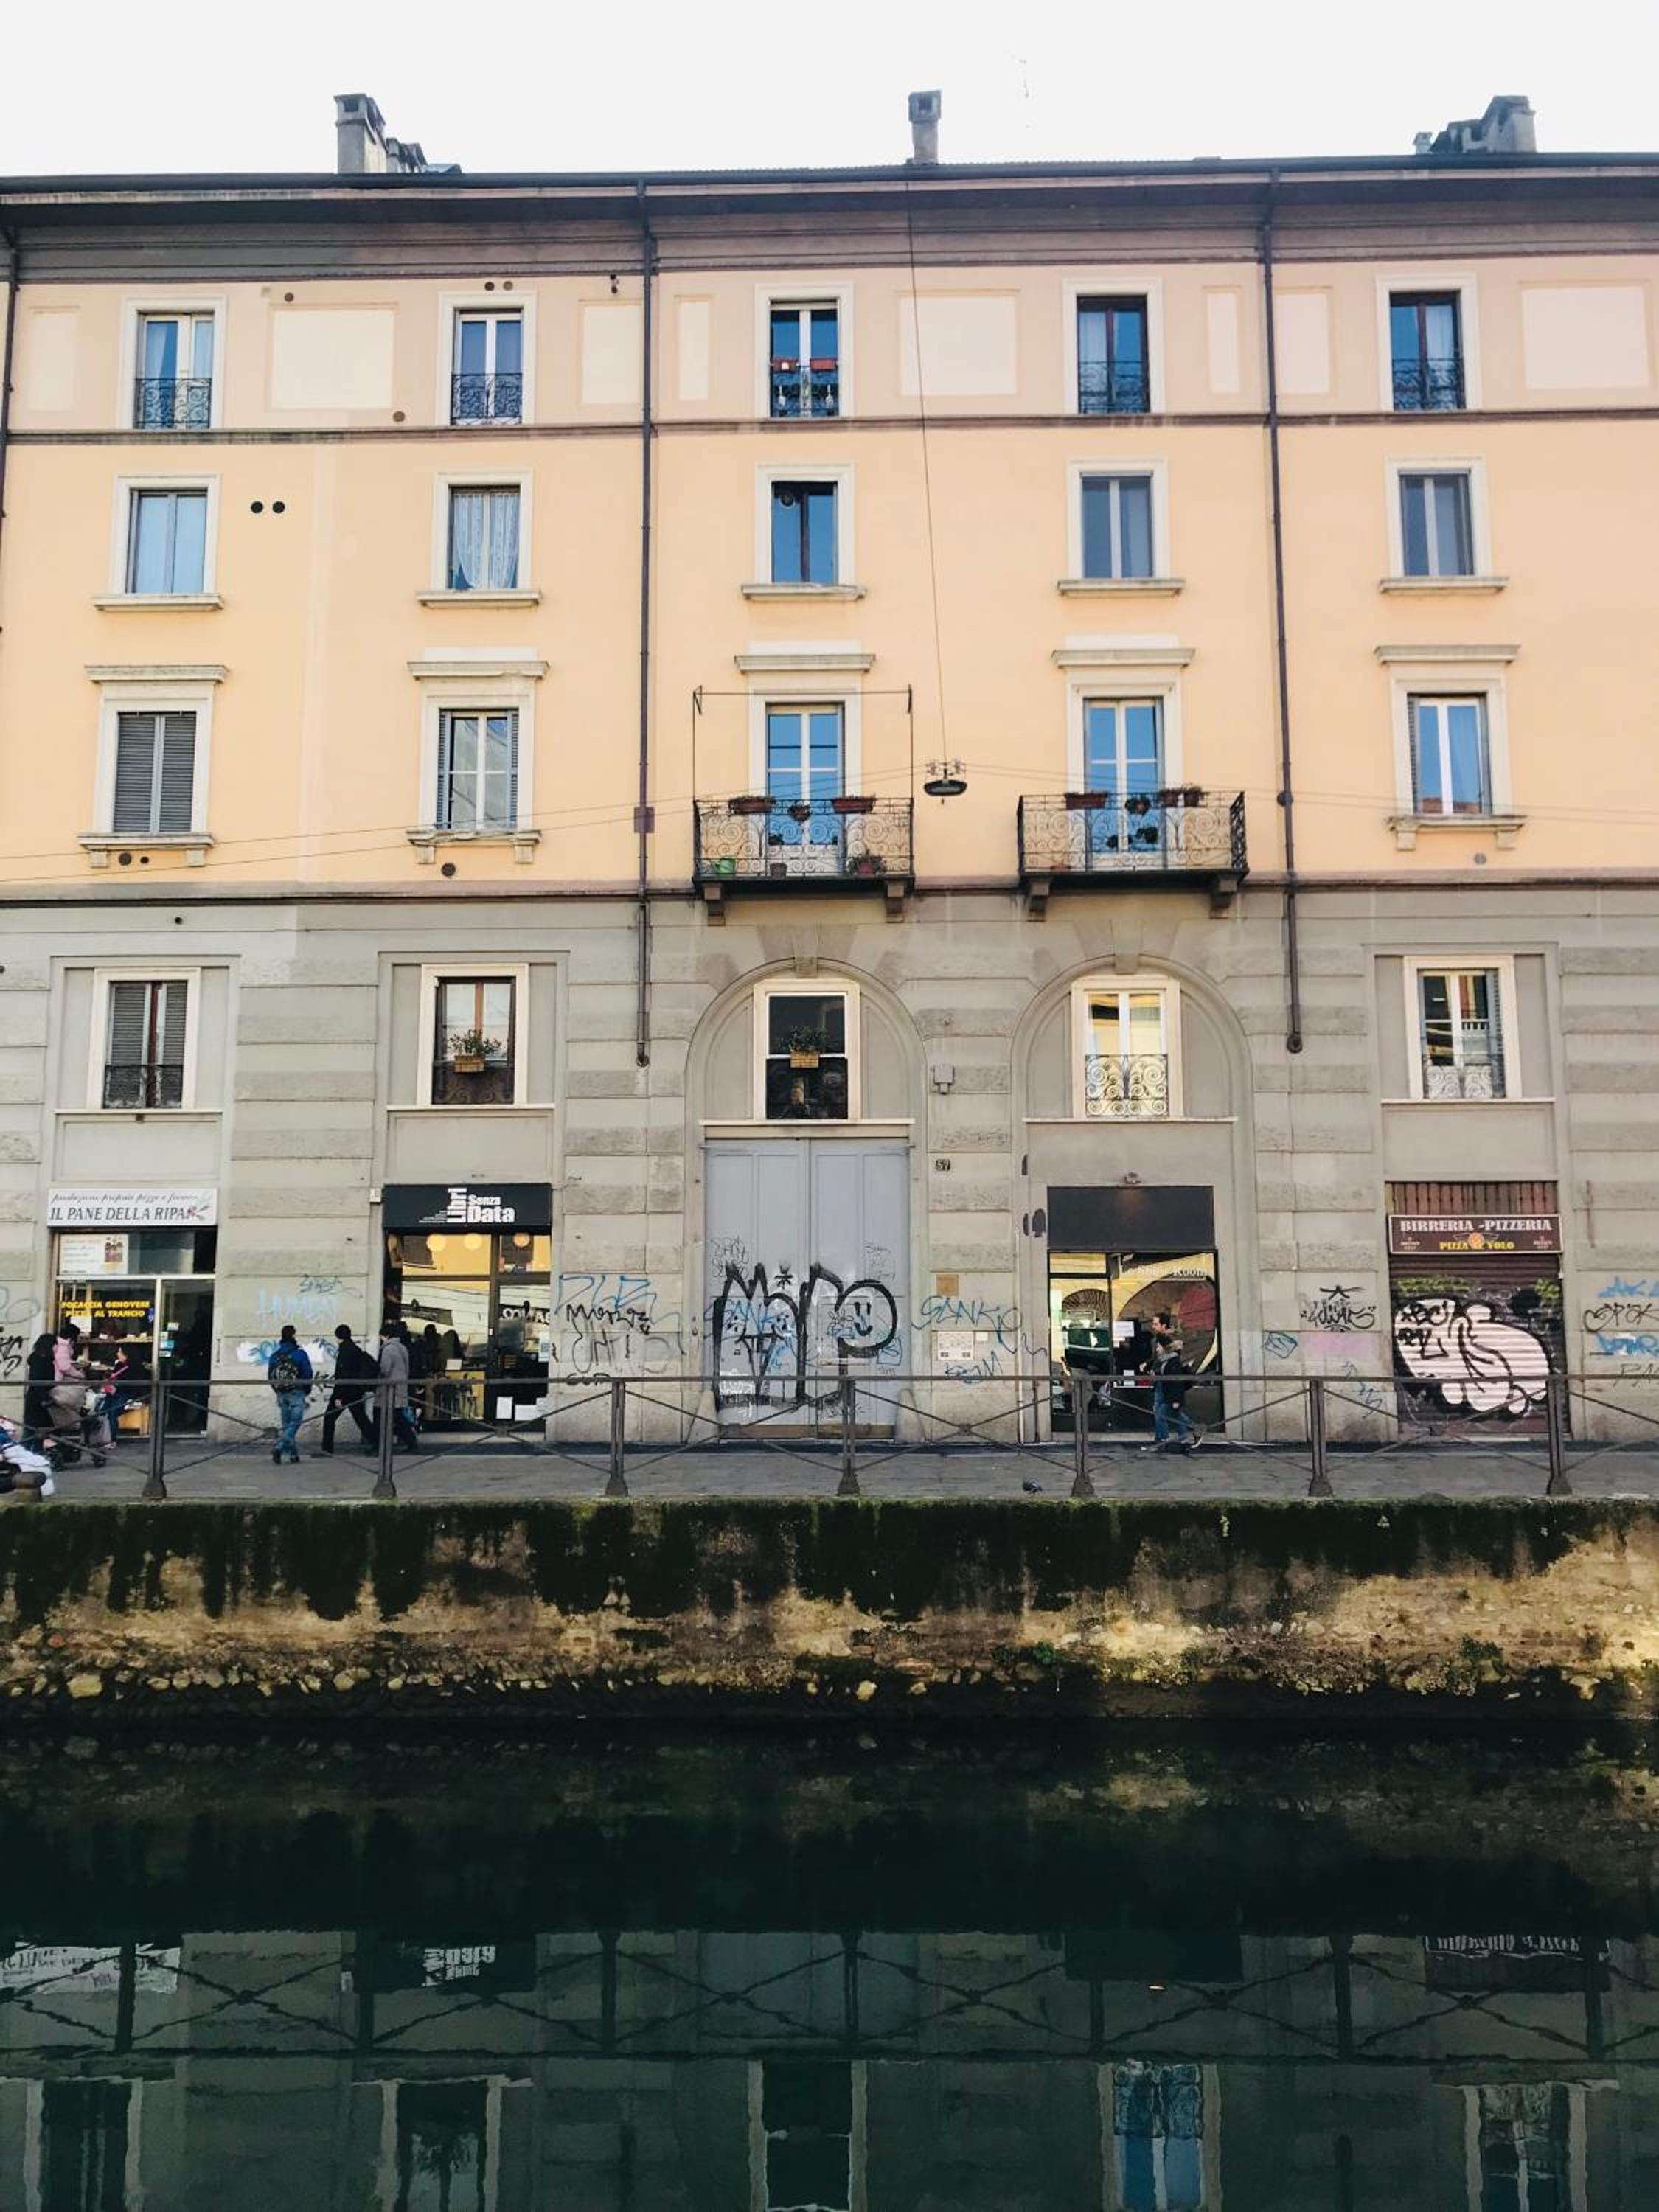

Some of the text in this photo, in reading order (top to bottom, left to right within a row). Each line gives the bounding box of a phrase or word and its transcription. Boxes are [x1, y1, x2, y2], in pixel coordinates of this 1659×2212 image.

[935, 1158, 951, 1172] 57
[446, 1188, 467, 1223] Libri
[467, 1194, 501, 1206] Senza
[49, 1207, 187, 1221] IL PANE DELLA RIPA
[467, 1206, 515, 1223] Data
[1400, 1220, 1475, 1232] BIRRERIA
[1439, 1241, 1469, 1251] PIZZA
[1486, 1241, 1515, 1251] VOLO
[94, 1310, 105, 1318] AL
[108, 1310, 145, 1318] TRANCIO
